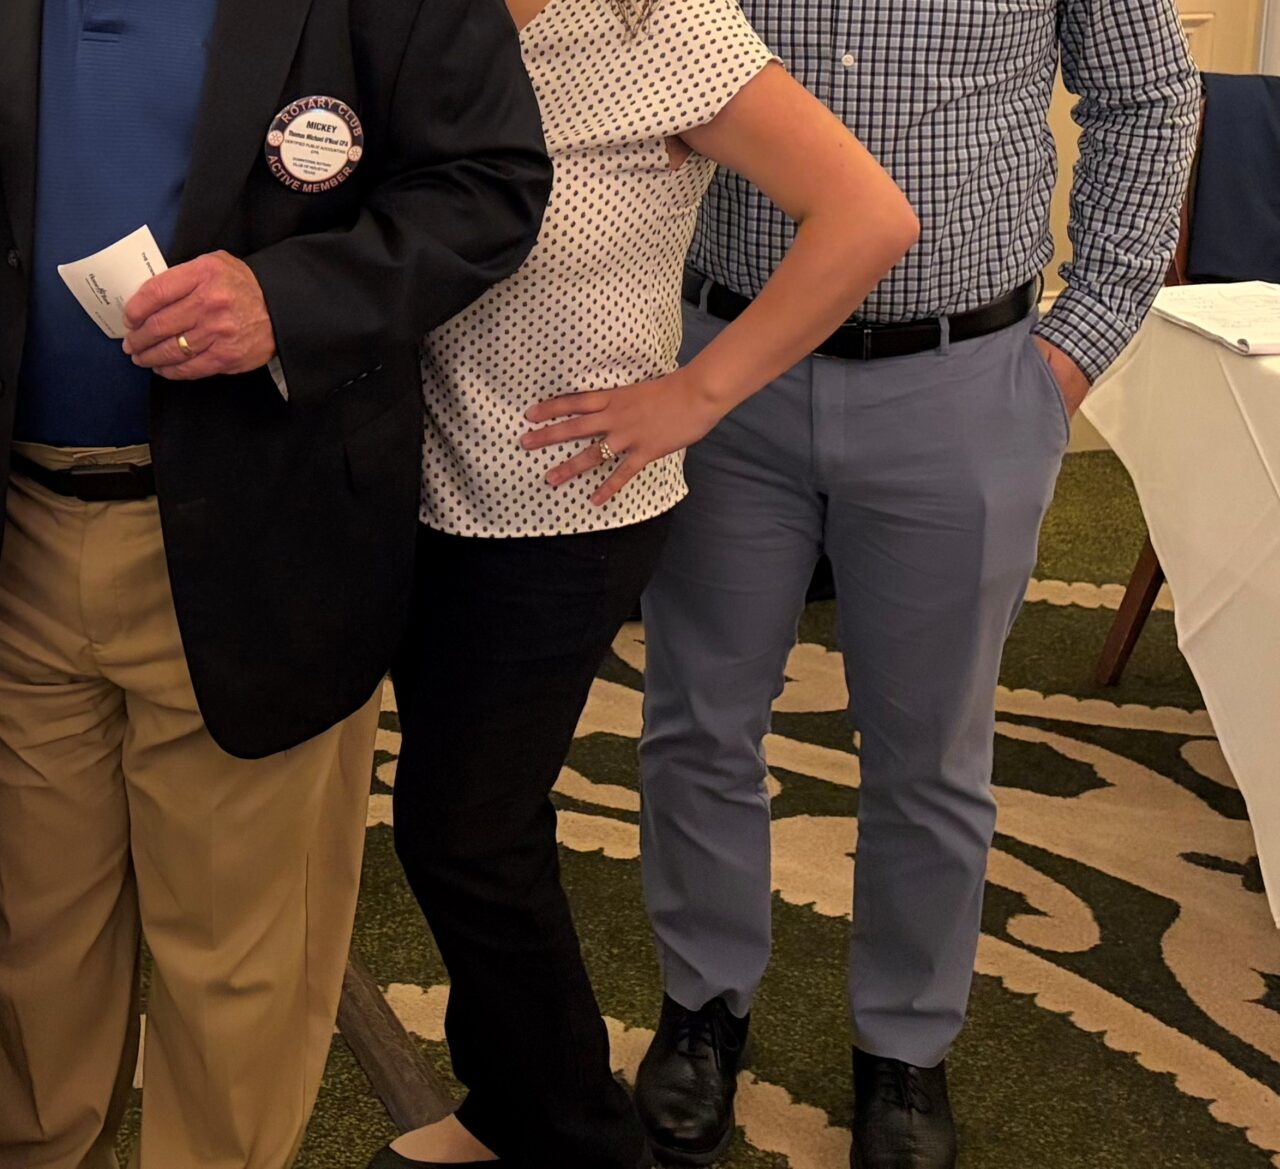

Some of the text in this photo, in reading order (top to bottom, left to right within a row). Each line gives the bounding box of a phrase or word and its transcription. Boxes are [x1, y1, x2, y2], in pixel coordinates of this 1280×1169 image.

[281, 98, 363, 137] ROTARY CLUB
[306, 120, 337, 133] MICKEY
[267, 155, 353, 193] ACTIVE MEMBER
